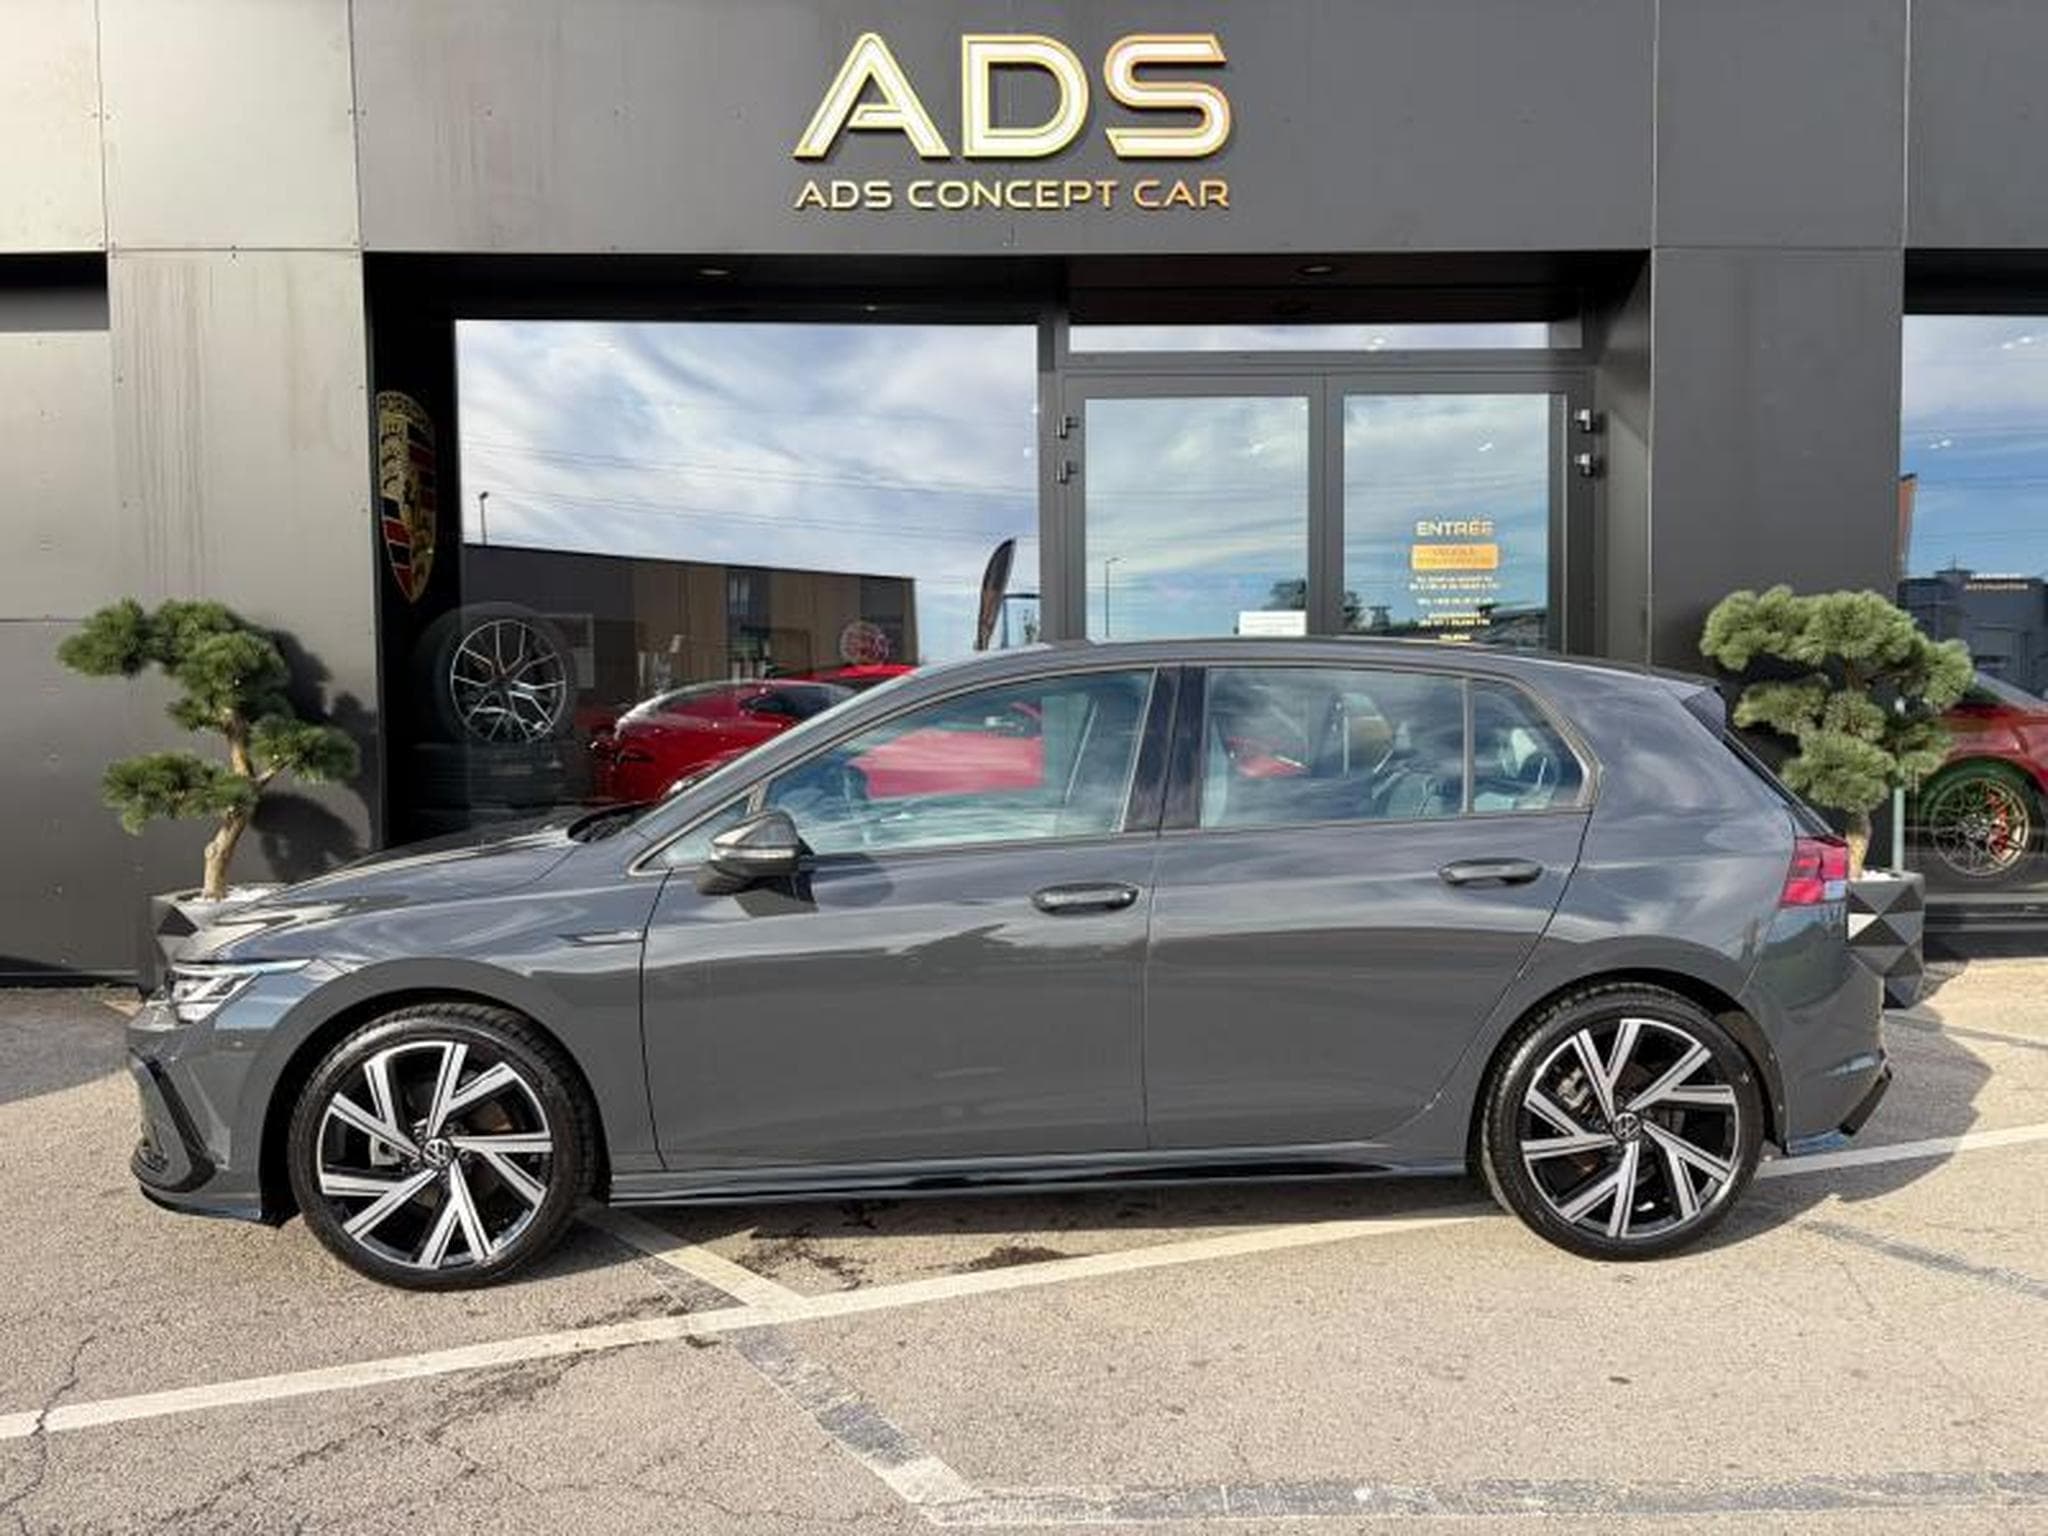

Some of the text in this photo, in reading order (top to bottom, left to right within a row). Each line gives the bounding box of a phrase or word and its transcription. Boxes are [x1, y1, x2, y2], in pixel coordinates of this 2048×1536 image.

[793, 32, 1231, 157] ADS
[794, 181, 1230, 208] ADS CONCEPT CAR
